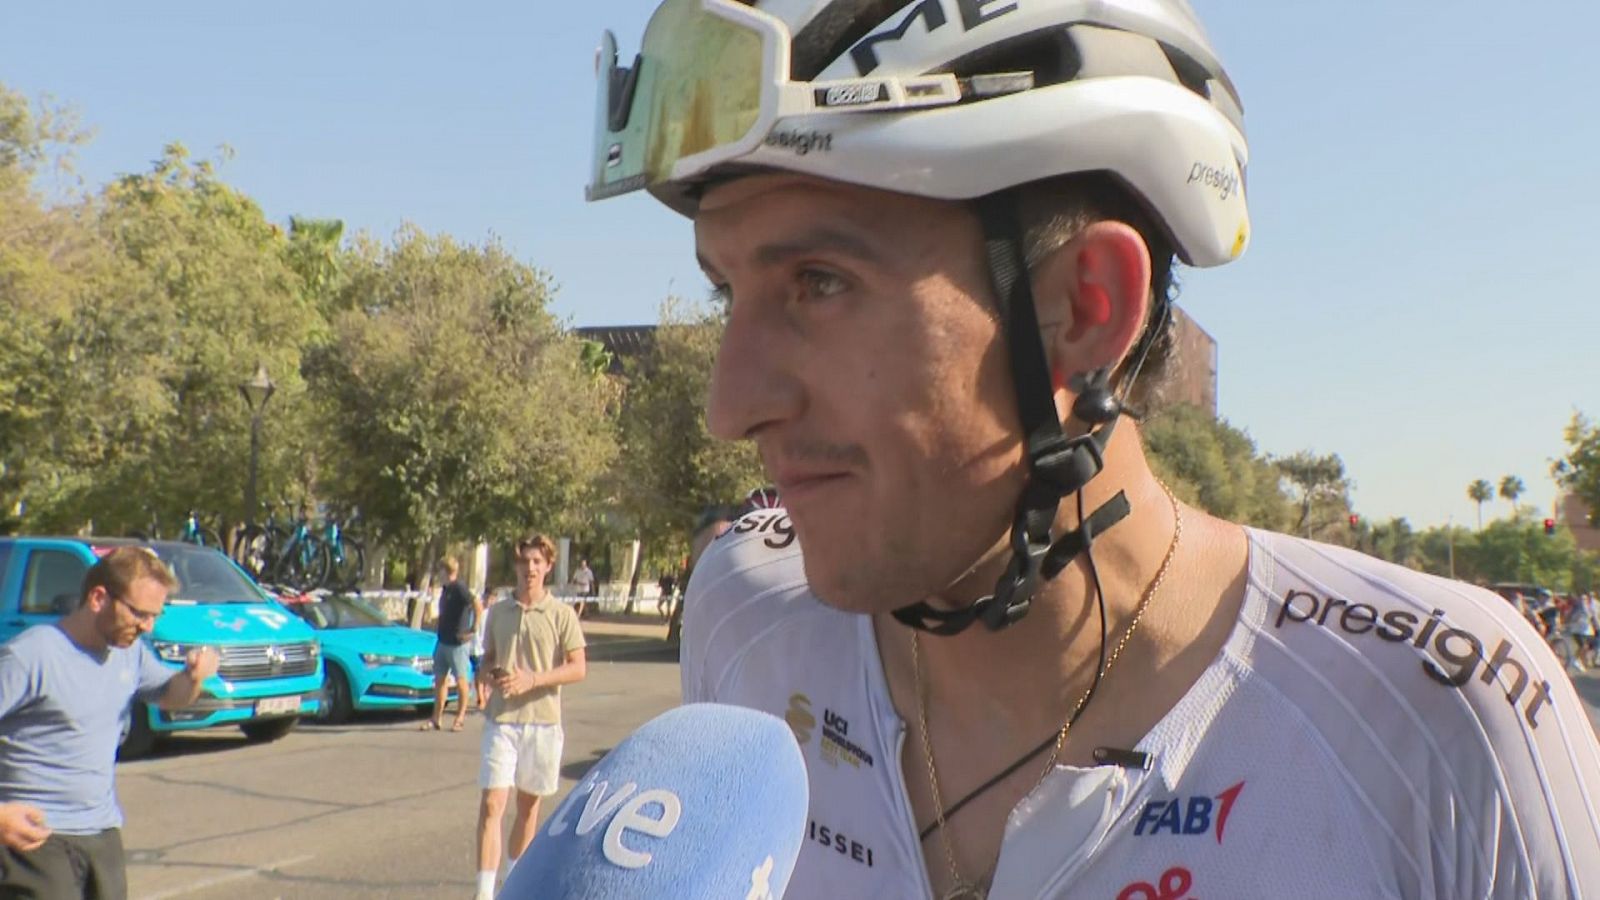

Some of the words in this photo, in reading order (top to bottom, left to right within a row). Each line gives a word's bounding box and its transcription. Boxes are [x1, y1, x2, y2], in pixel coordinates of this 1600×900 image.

[765, 129, 832, 155] esight
[1187, 161, 1239, 200] presigh
[715, 514, 796, 549] sig
[1274, 588, 1554, 730] presight
[823, 708, 848, 735] UCI
[810, 820, 873, 867] ISSEI
